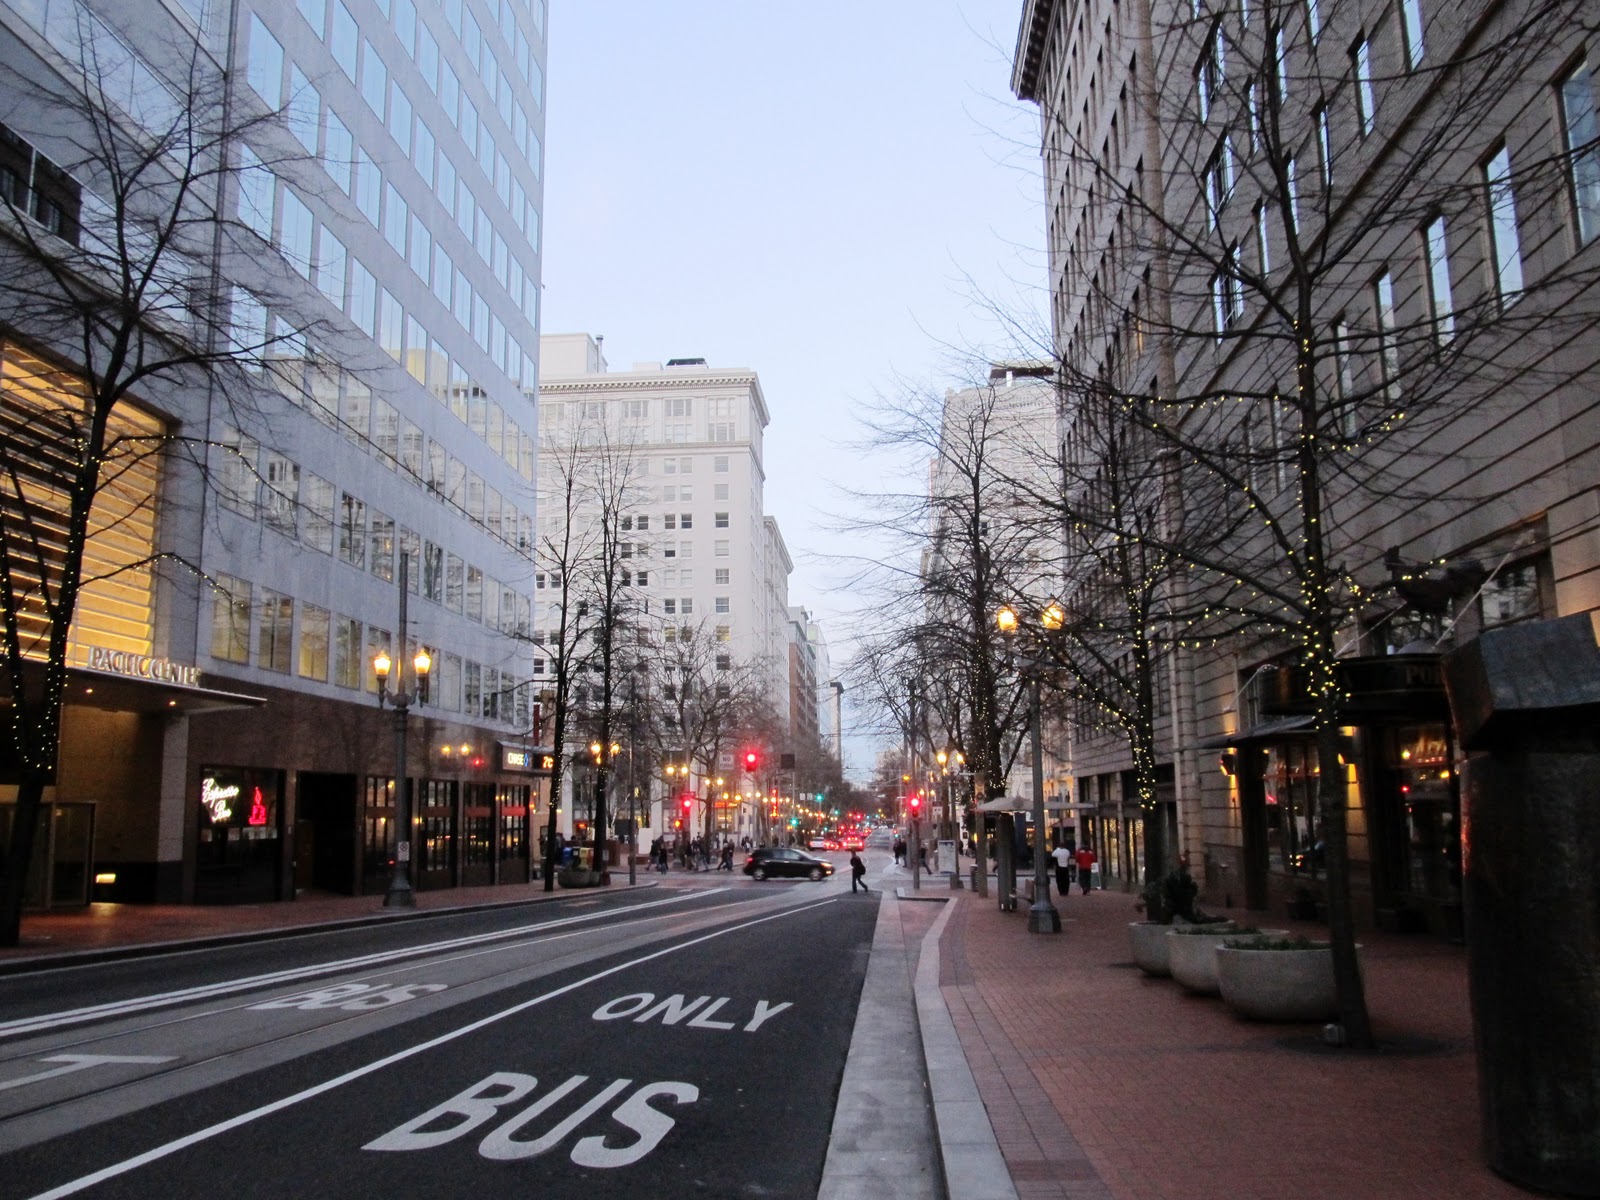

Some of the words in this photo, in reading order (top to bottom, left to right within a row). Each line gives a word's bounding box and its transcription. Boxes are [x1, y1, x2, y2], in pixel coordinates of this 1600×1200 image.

[88, 646, 149, 678] PACIFIC
[149, 658, 201, 687] CENTER
[508, 752, 525, 766] CHASE
[202, 777, 240, 808] Espresso
[246, 983, 448, 1010] BUS
[592, 992, 794, 1032] ONLY
[361, 1072, 700, 1168] BUS
